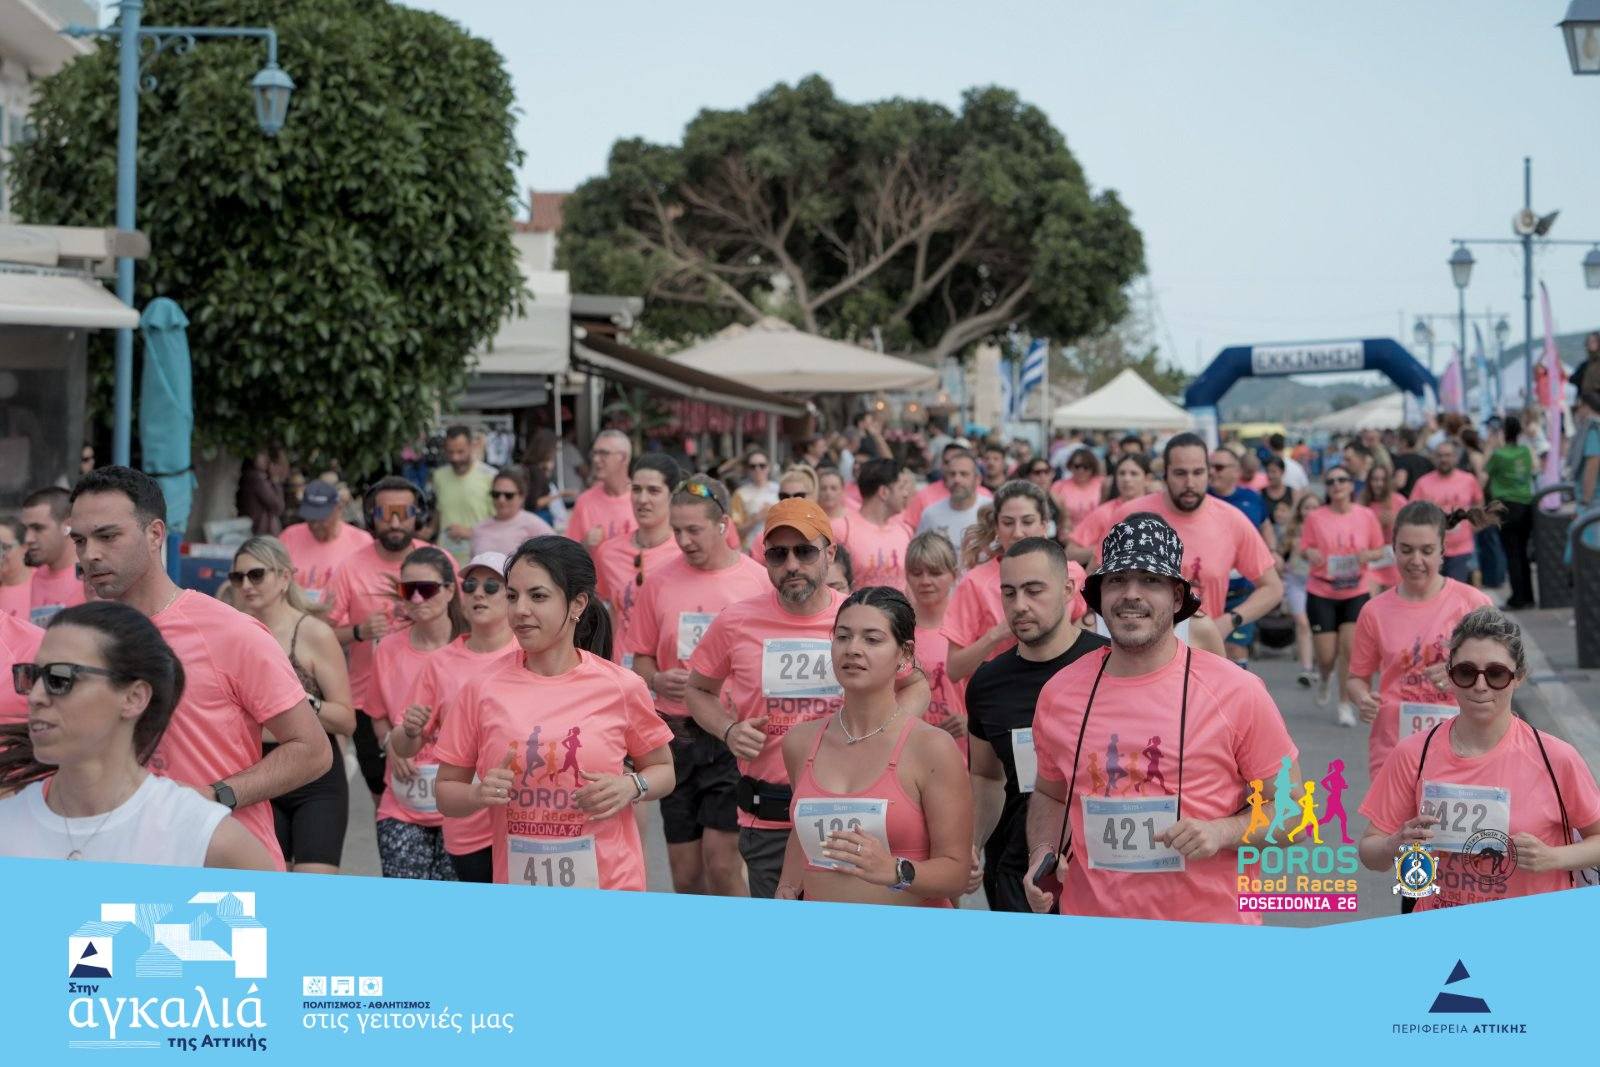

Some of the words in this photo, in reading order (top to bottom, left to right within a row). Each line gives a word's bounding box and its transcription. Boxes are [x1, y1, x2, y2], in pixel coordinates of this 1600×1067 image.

[780, 653, 826, 679] 224
[507, 809, 536, 821] Road
[541, 811, 583, 823] Races
[1436, 801, 1488, 832] 422
[1103, 818, 1156, 850] 421
[523, 856, 576, 887] 418
